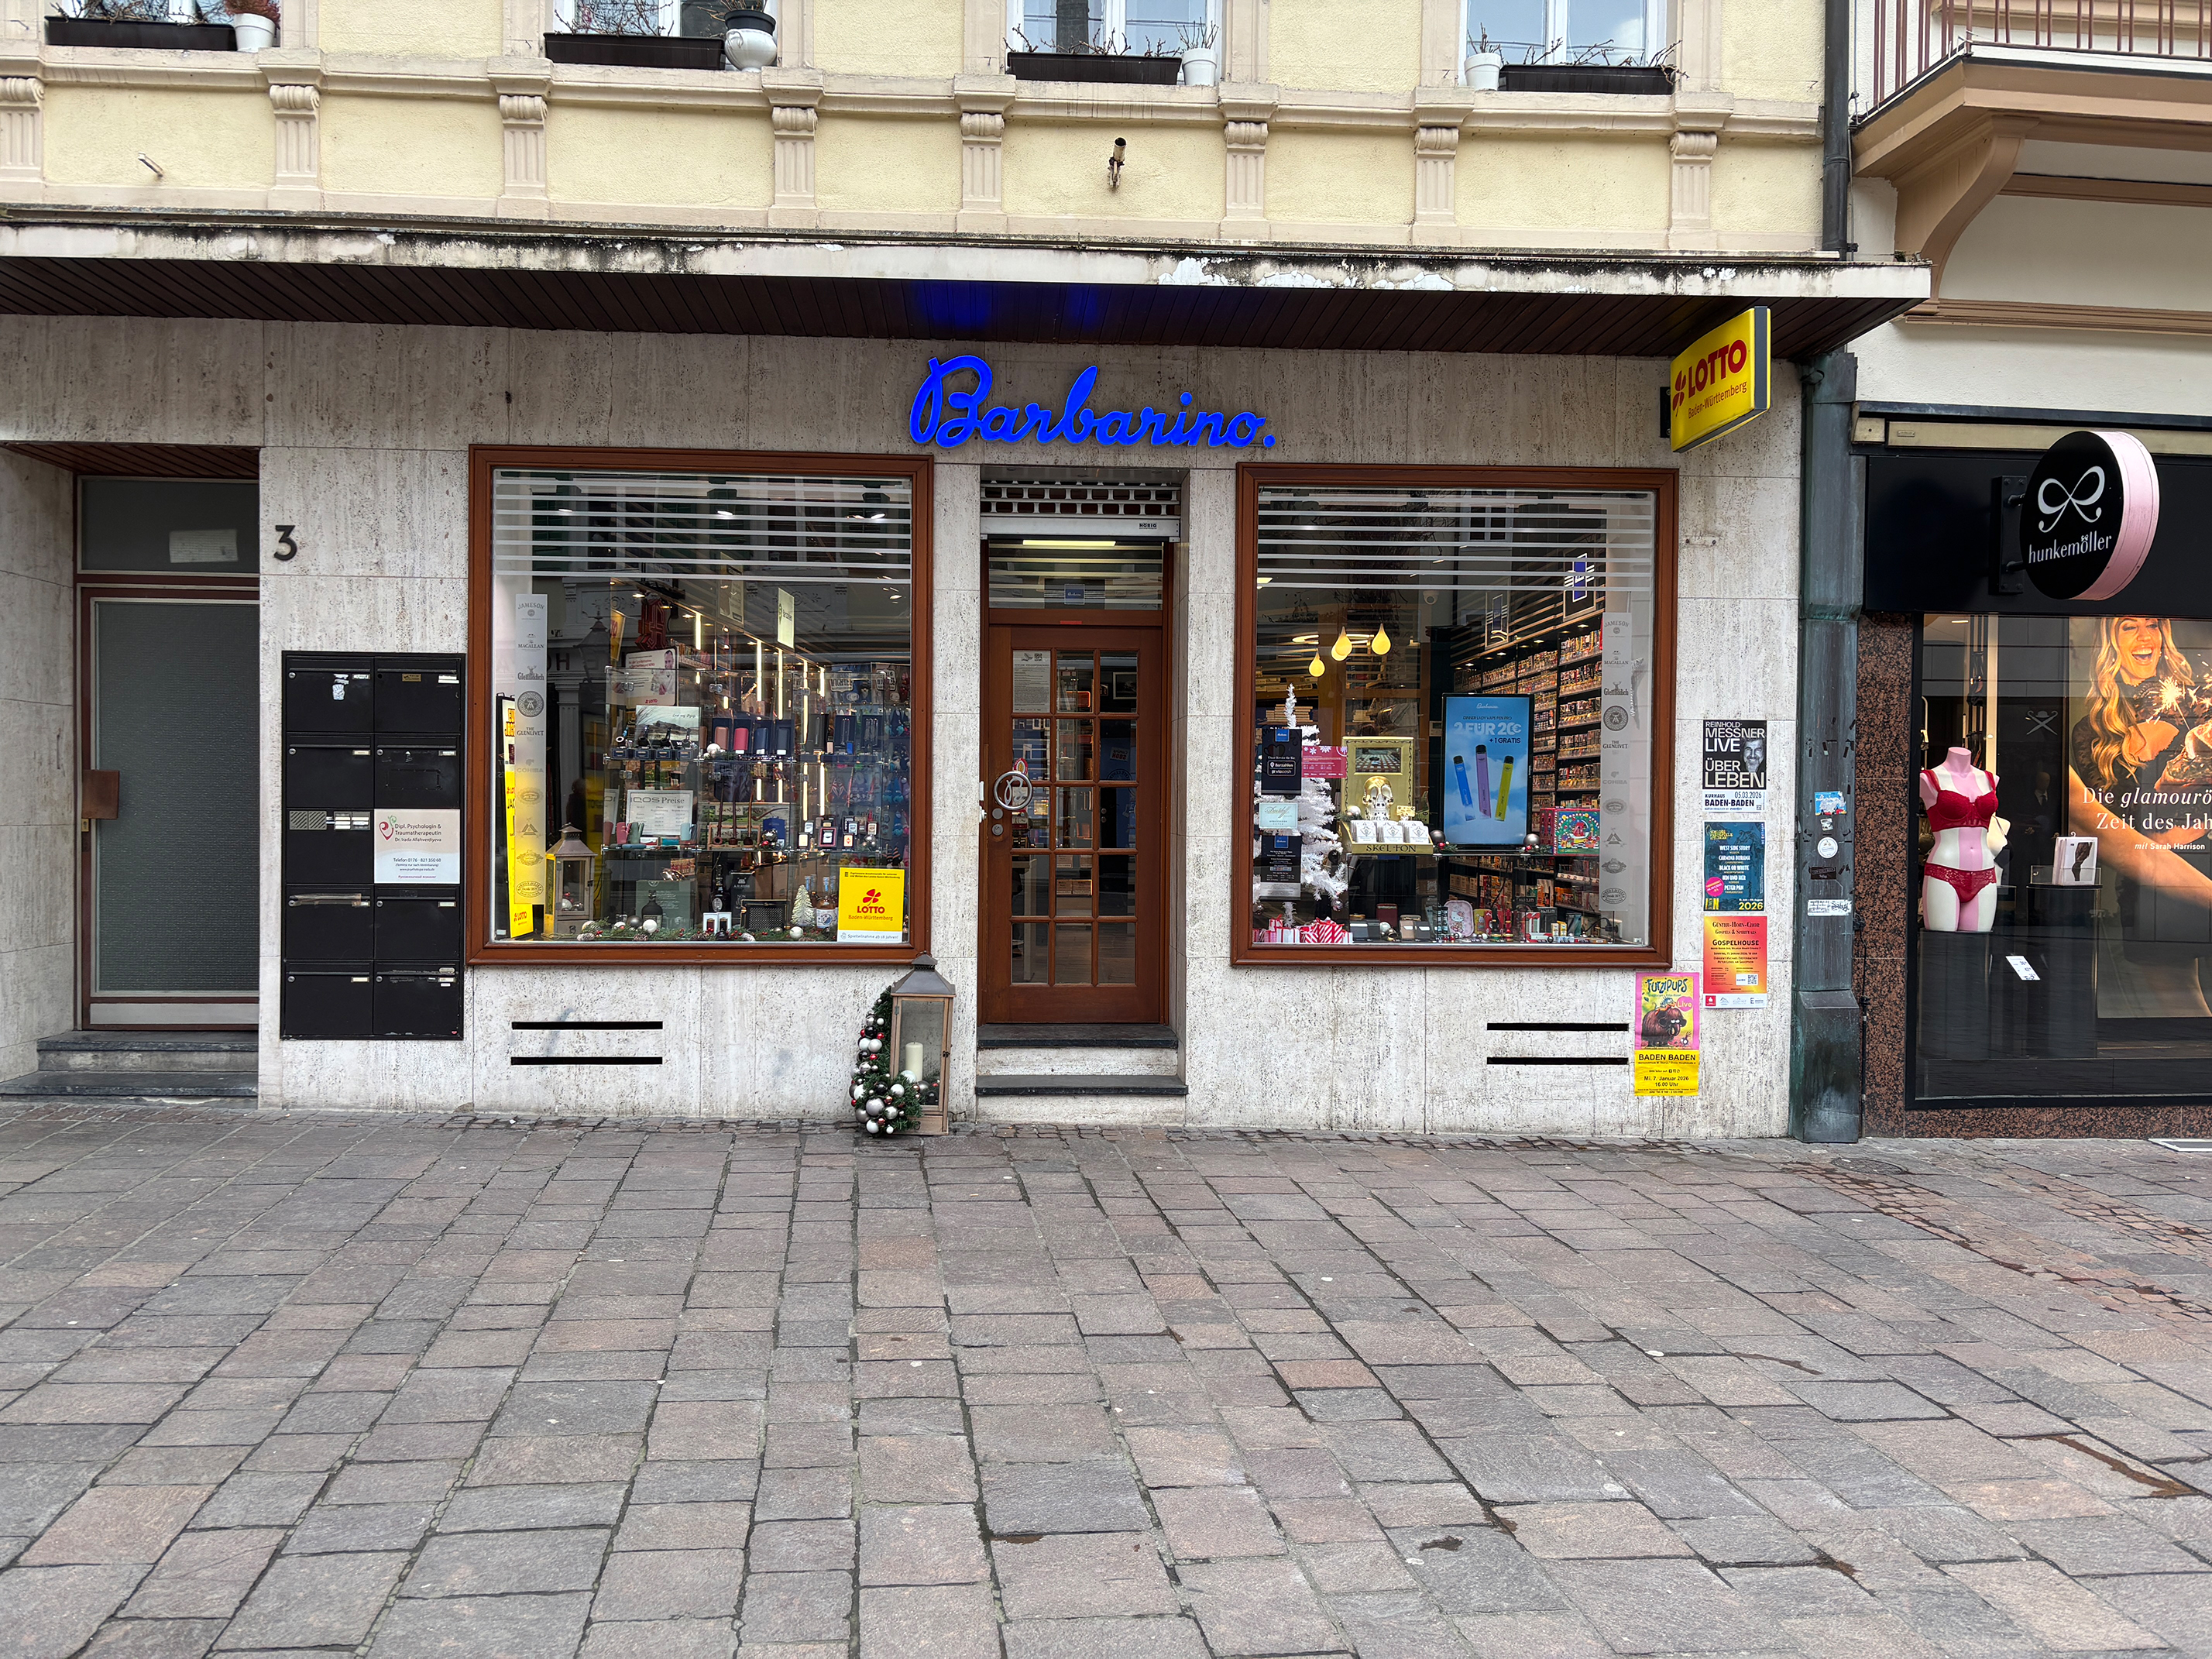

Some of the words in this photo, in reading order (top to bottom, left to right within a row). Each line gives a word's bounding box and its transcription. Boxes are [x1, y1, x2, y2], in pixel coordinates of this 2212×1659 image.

[1688, 339, 1747, 398] LOTTO
[1688, 381, 1748, 419] Baden-Württemberg
[273, 525, 297, 562] 3
[2028, 531, 2112, 563] hunkemöller
[1465, 722, 1496, 735] FÜR
[1705, 728, 1765, 738] MESSNER
[1705, 738, 1740, 751] LIVE
[1705, 757, 1740, 771] ÜBER
[1705, 772, 1764, 787] LEBEN
[2083, 788, 2114, 804] Die
[2097, 813, 2135, 830] Zeit
[2142, 813, 2173, 830] des
[1739, 902, 1763, 910] 2026
